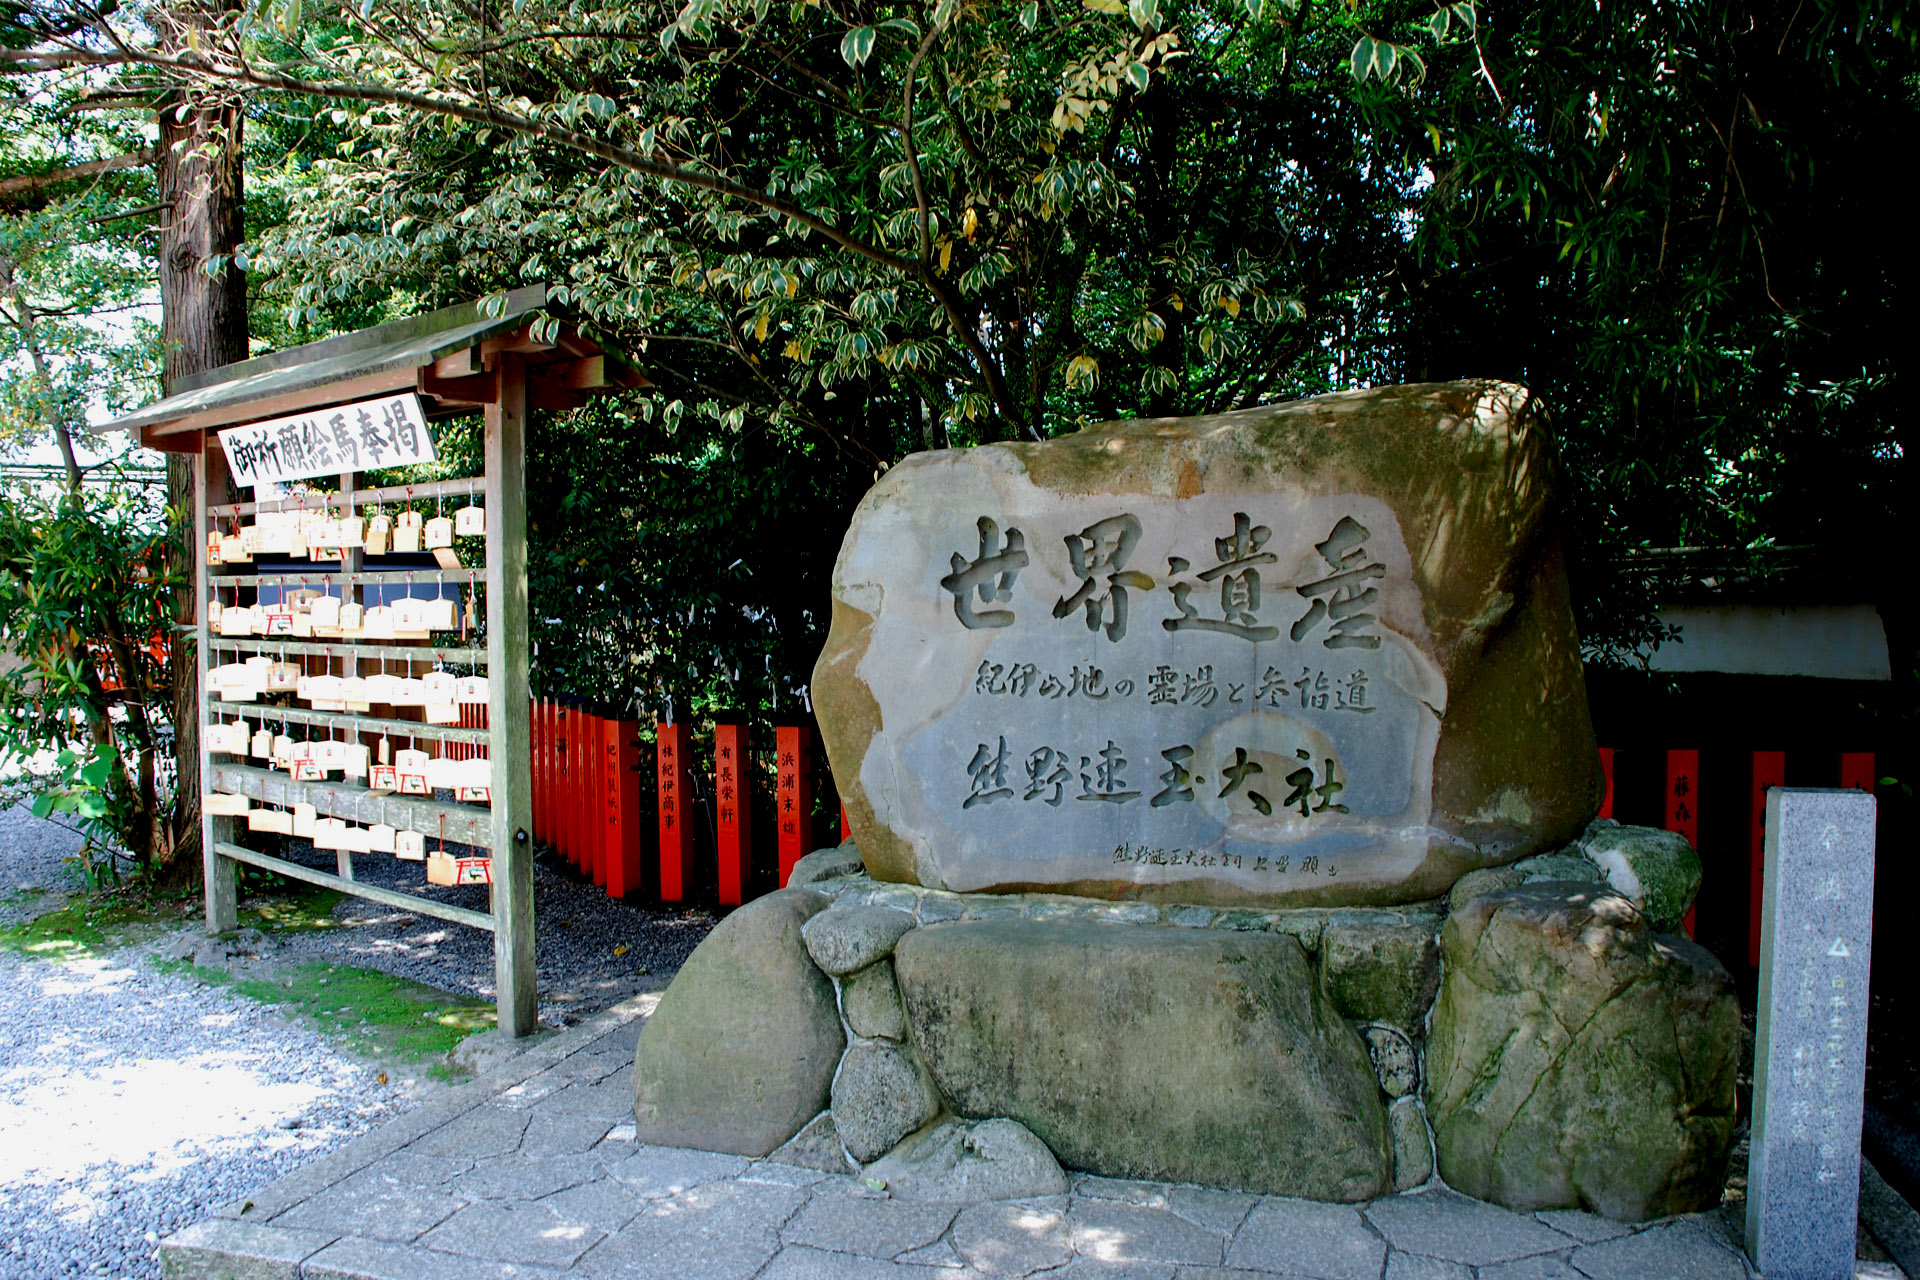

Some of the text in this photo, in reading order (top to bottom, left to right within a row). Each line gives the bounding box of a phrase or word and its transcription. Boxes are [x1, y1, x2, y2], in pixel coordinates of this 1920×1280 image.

[228, 399, 417, 480] 御祈願絵馬奉掲
[976, 660, 1377, 715] 紀伊山地の霊場と参詣道
[963, 736, 1350, 817] 熊野速玉大社
